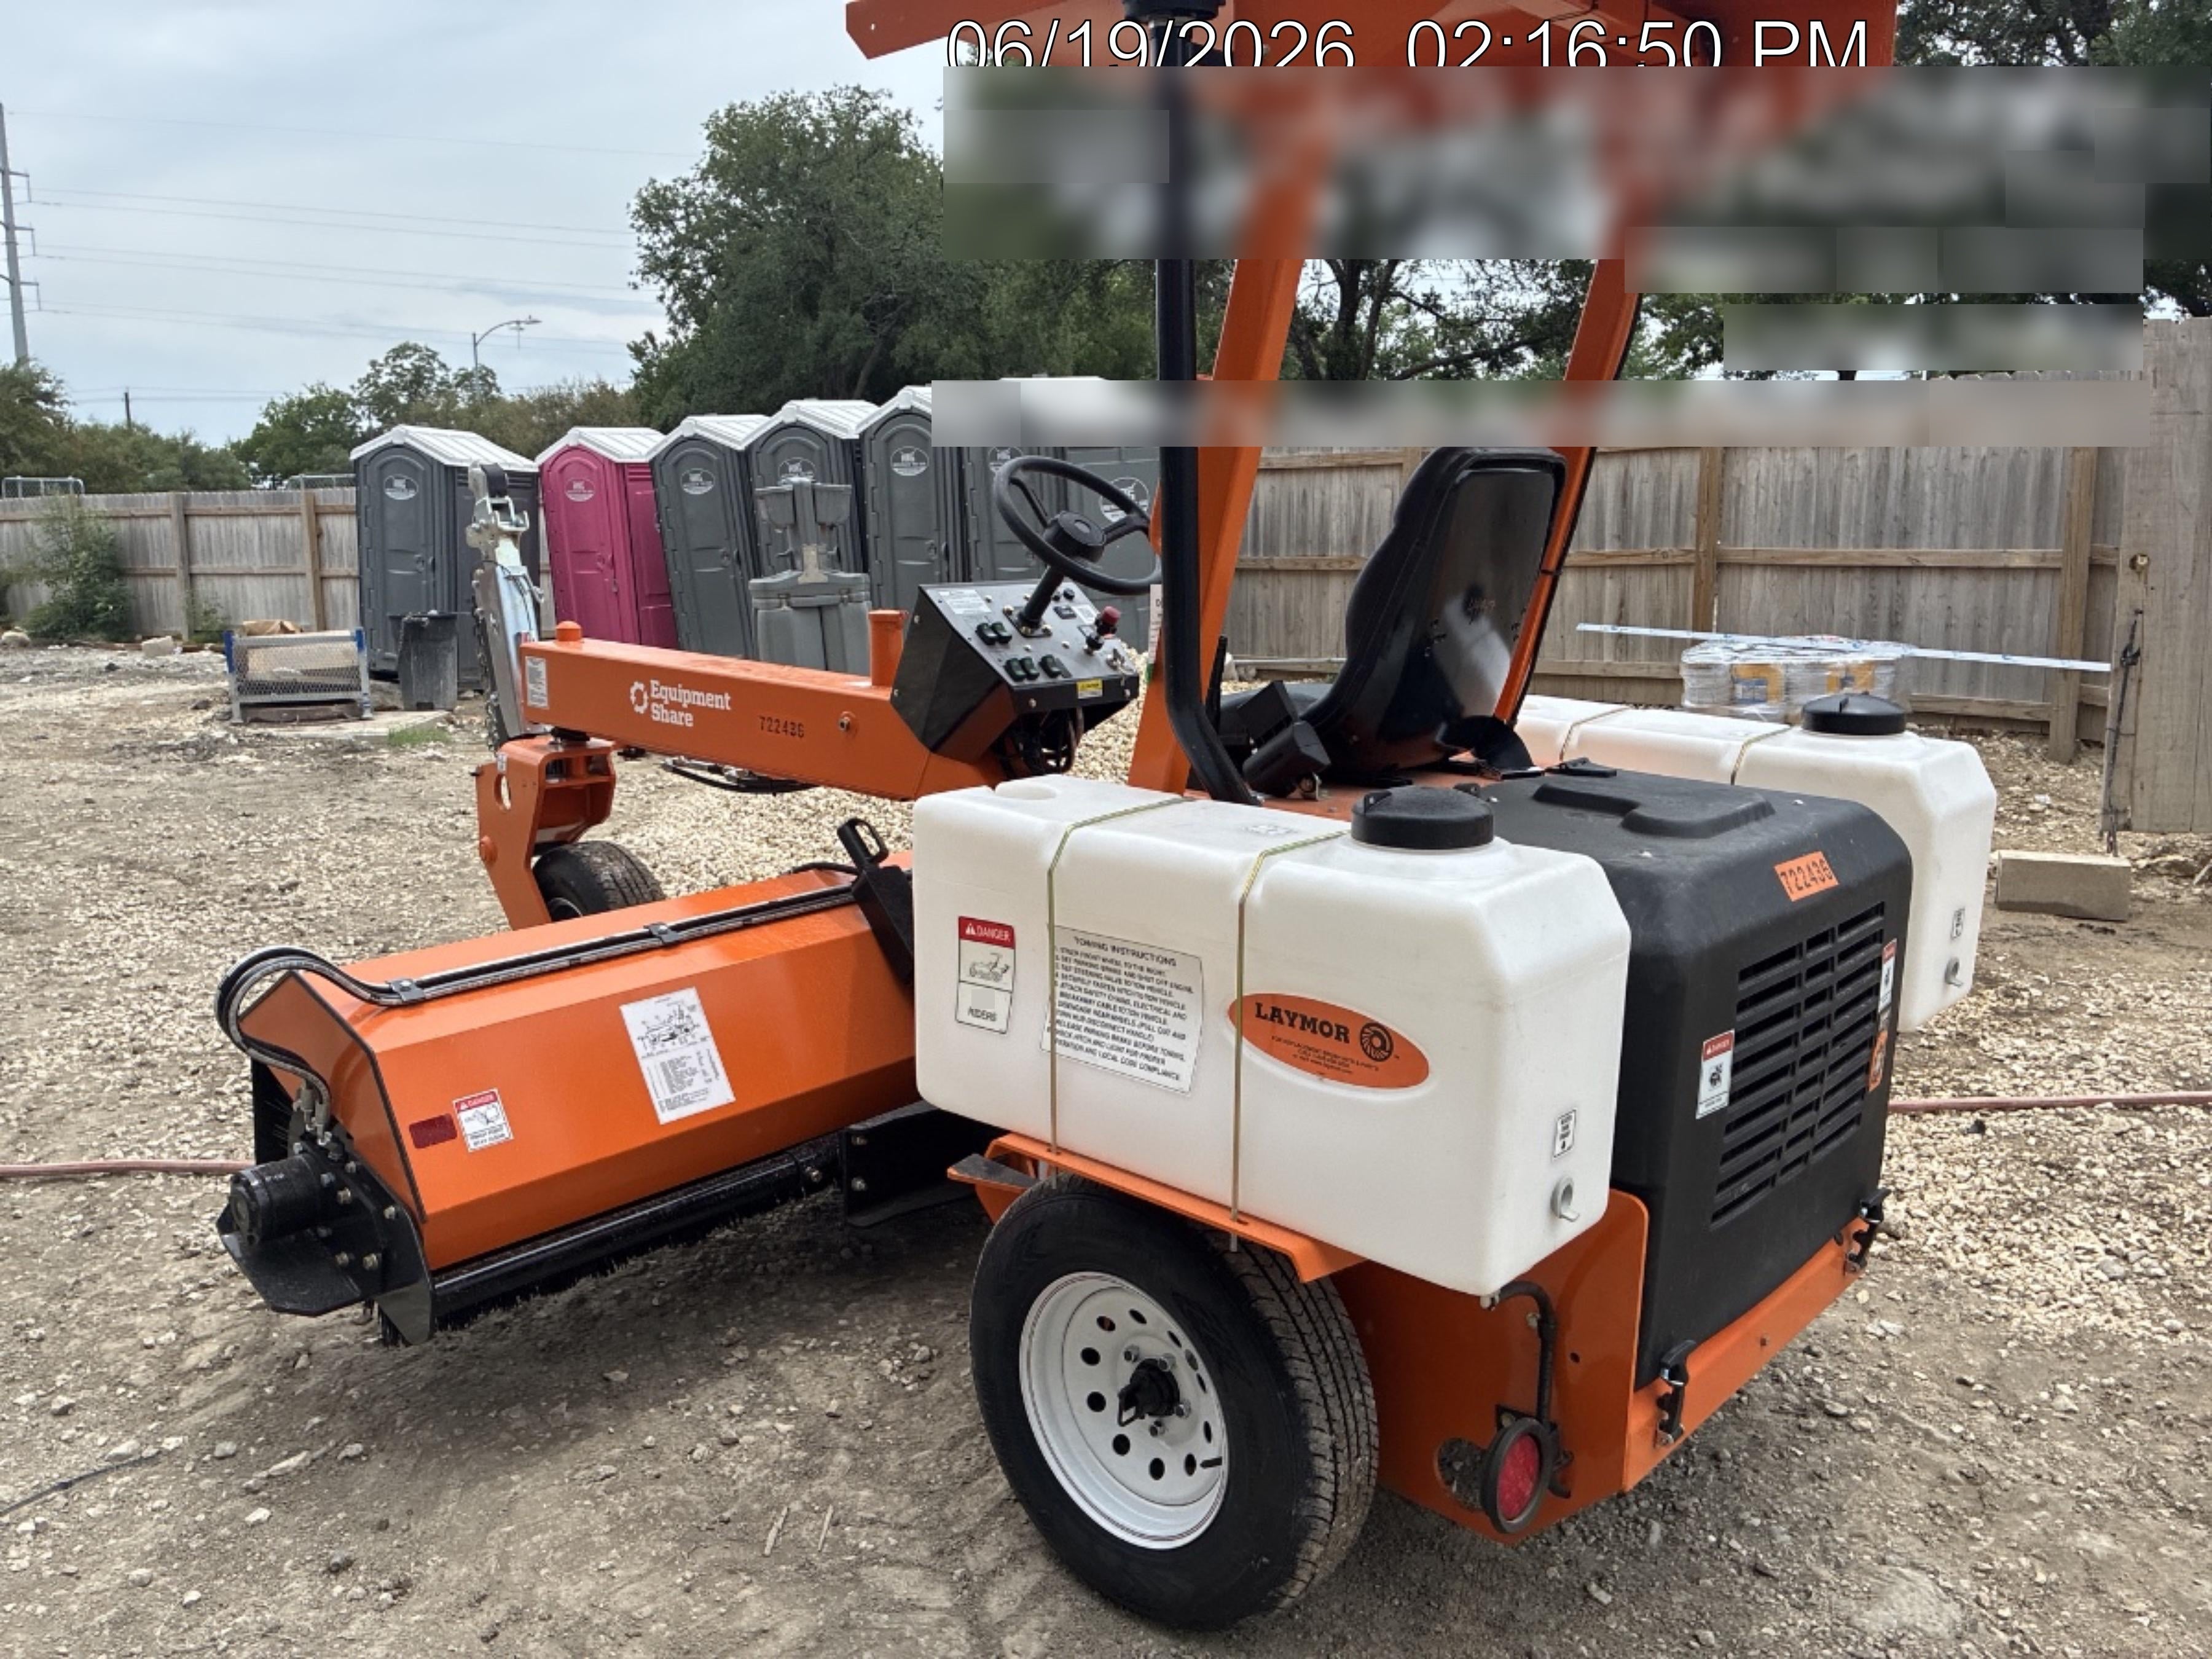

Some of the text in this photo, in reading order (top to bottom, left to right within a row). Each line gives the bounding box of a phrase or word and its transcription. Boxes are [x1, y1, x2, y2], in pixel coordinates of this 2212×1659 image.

[650, 680, 731, 710] Equipment
[651, 703, 694, 727] Share
[1780, 858, 1833, 894] 722436
[976, 925, 1010, 941] DANGER
[1073, 935, 1177, 967] TOWING INSTRUCTIONS
[1255, 1002, 1350, 1044] LAYMOR
